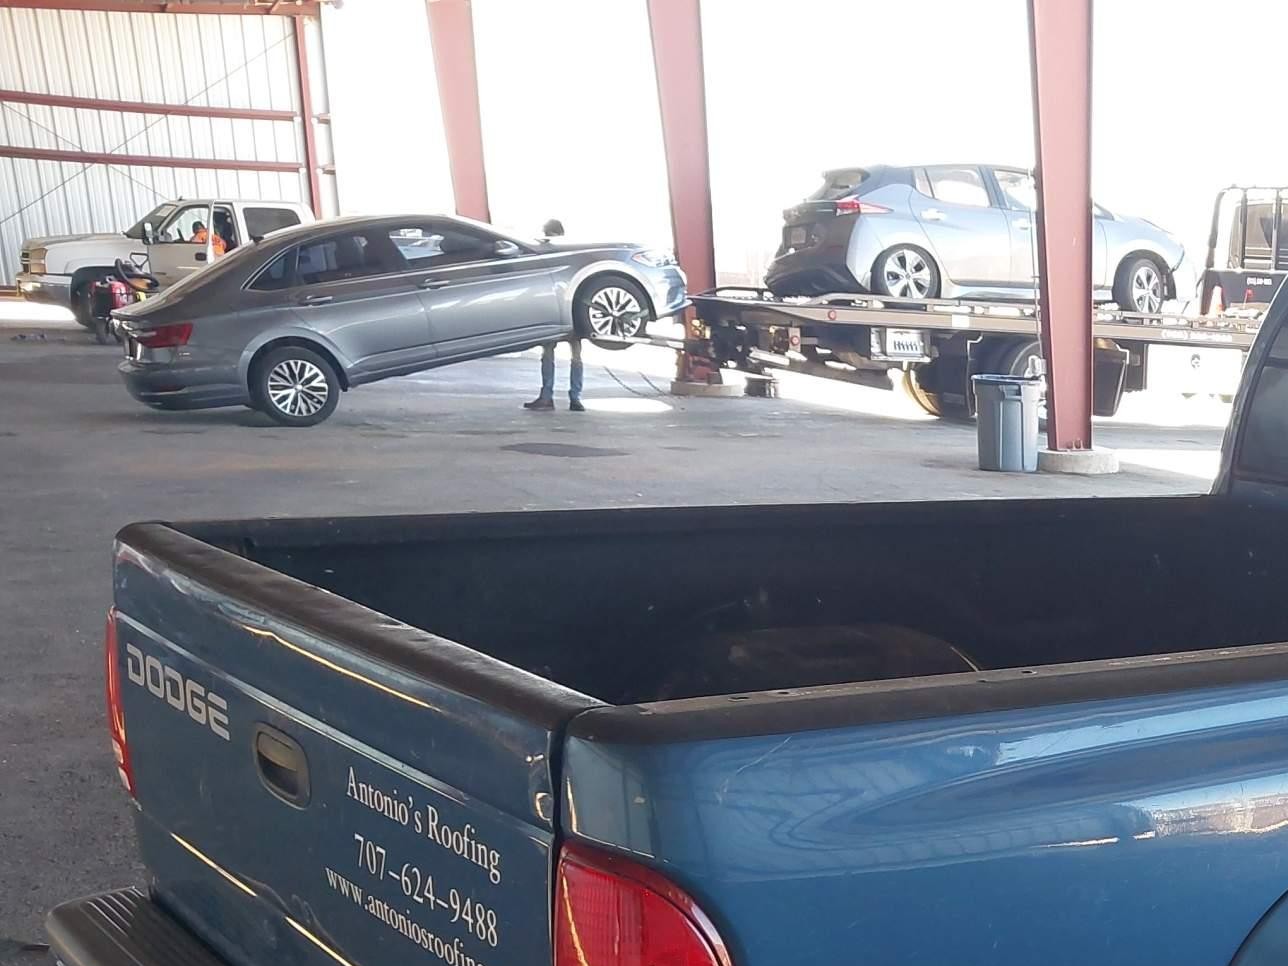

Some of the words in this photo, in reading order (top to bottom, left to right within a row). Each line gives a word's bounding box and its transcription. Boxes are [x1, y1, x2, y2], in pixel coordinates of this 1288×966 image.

[126, 644, 231, 741] DODGE
[347, 766, 423, 834] Antonio's
[427, 804, 501, 883] Roofing
[353, 833, 498, 947] 707-624-9488
